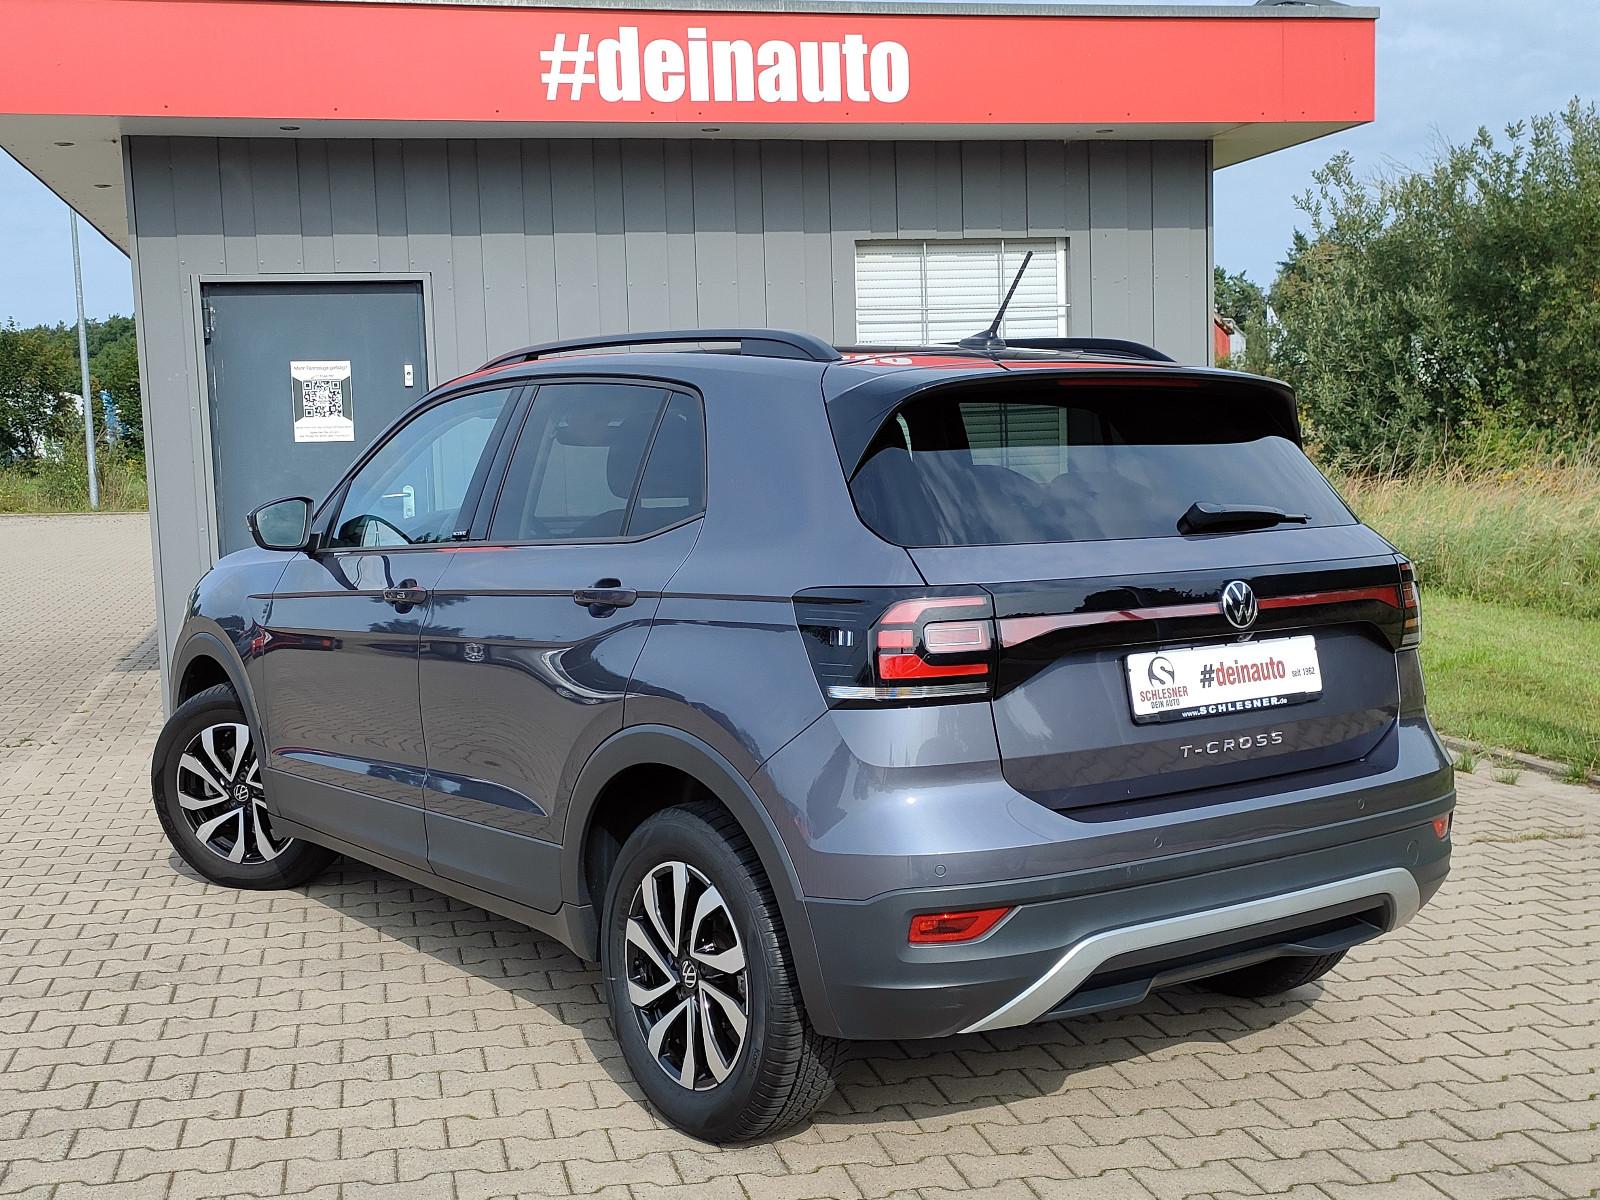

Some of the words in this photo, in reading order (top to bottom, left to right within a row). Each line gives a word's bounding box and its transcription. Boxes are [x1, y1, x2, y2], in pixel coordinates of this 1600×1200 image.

[539, 26, 910, 103] #deinauto
[1200, 656, 1286, 689] #deinauto
[1139, 685, 1189, 702] SCHLESNER
[1150, 700, 1165, 709] DEIN
[1165, 698, 1181, 707] AUTO
[1181, 696, 1288, 718] www.SCHLESNER.de
[1180, 731, 1284, 758] T-CROSS
